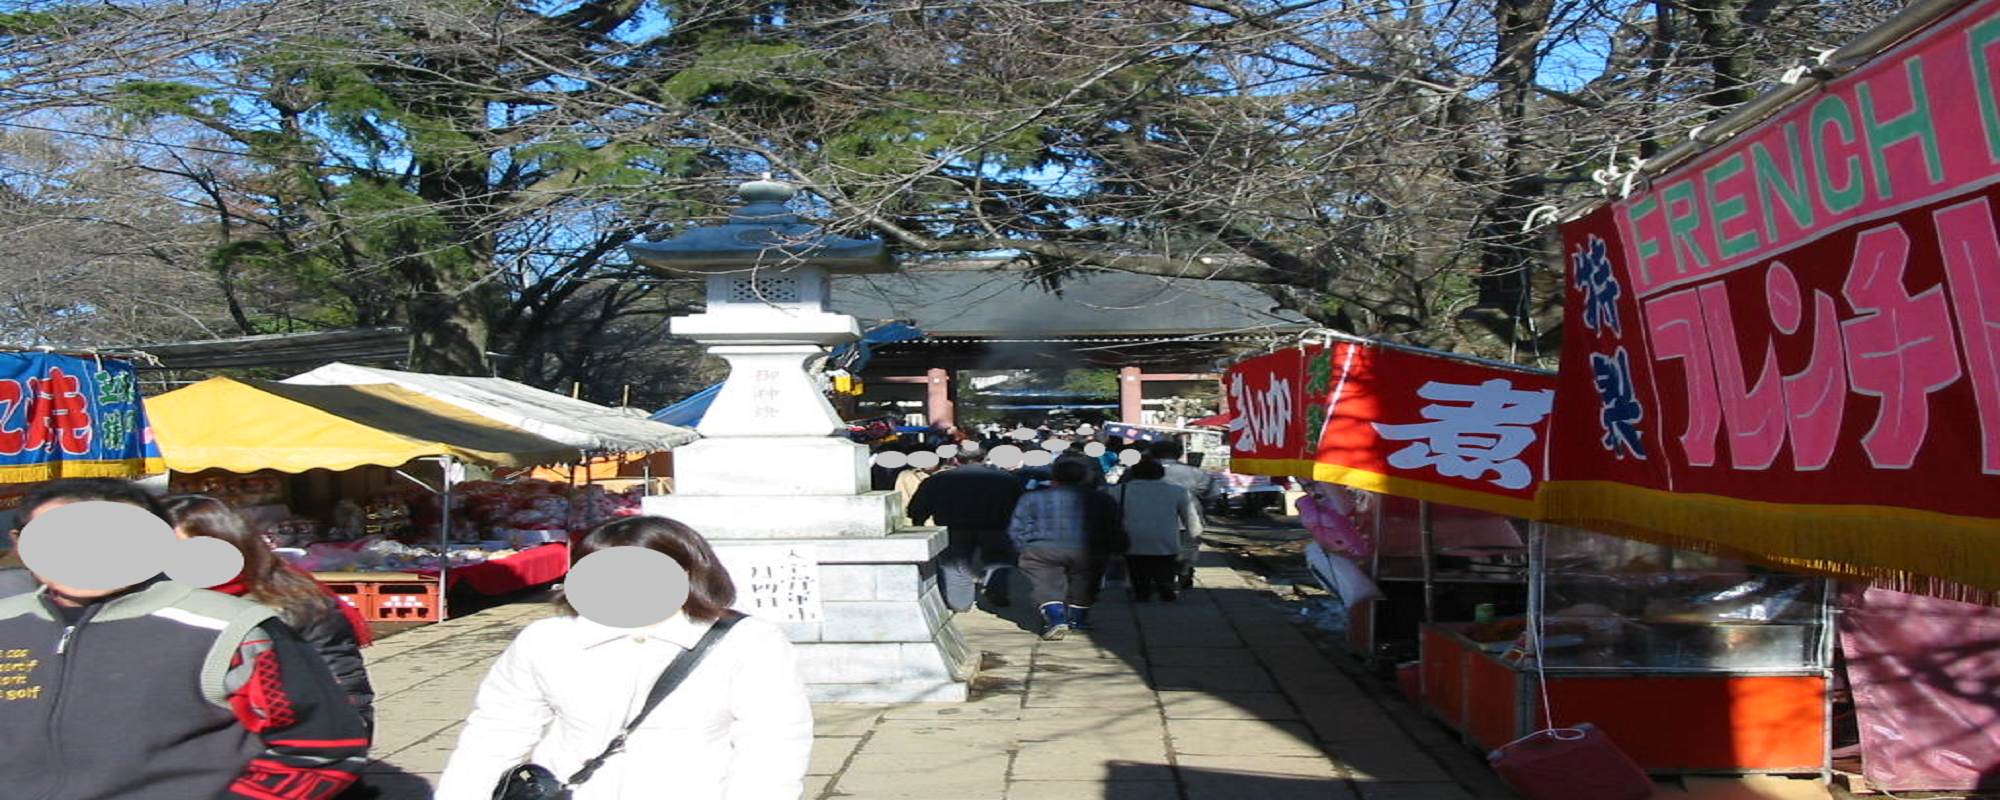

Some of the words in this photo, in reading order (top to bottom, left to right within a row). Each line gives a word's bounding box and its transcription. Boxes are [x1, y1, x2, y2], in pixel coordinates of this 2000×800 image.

[1628, 56, 1944, 285] FRENCH
[1370, 379, 1556, 489] 煮
[1572, 233, 1647, 460] 特製
